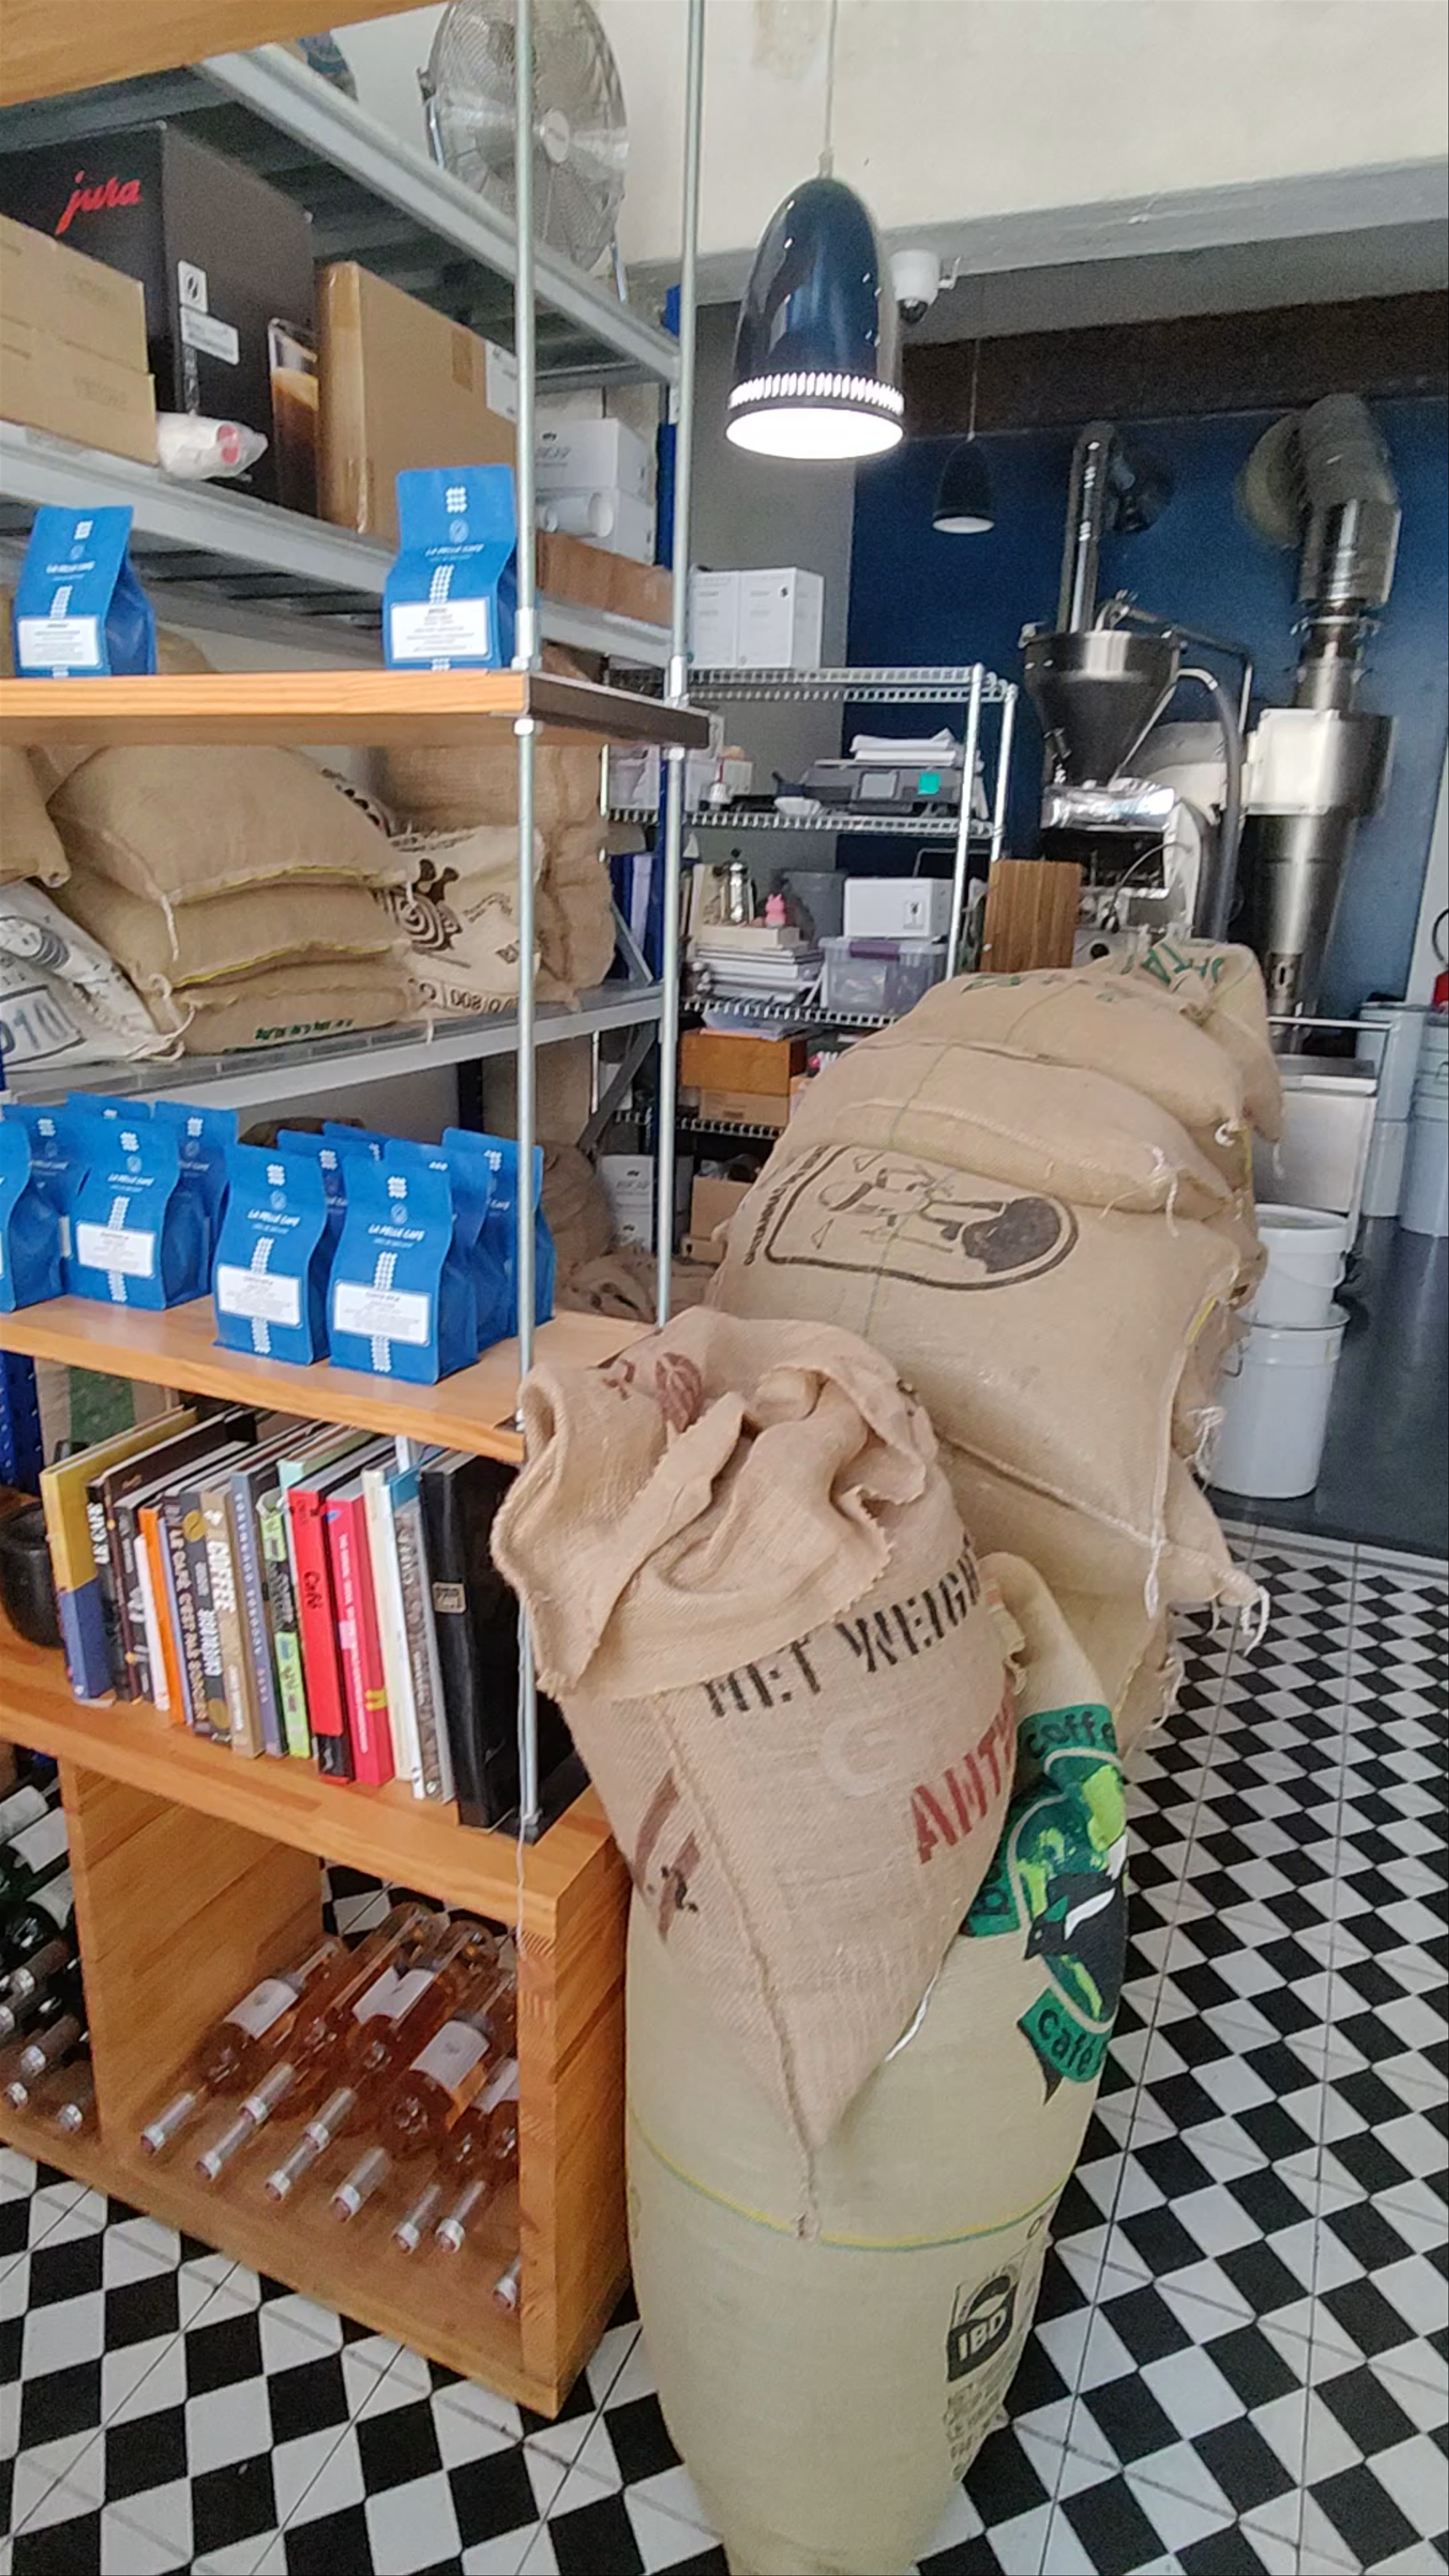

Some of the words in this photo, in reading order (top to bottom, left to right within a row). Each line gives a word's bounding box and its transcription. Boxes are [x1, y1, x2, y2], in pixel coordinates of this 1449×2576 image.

[55, 171, 141, 236] jura
[206, 1541, 237, 1613] COFFEE
[957, 2307, 1007, 2362] IBD
